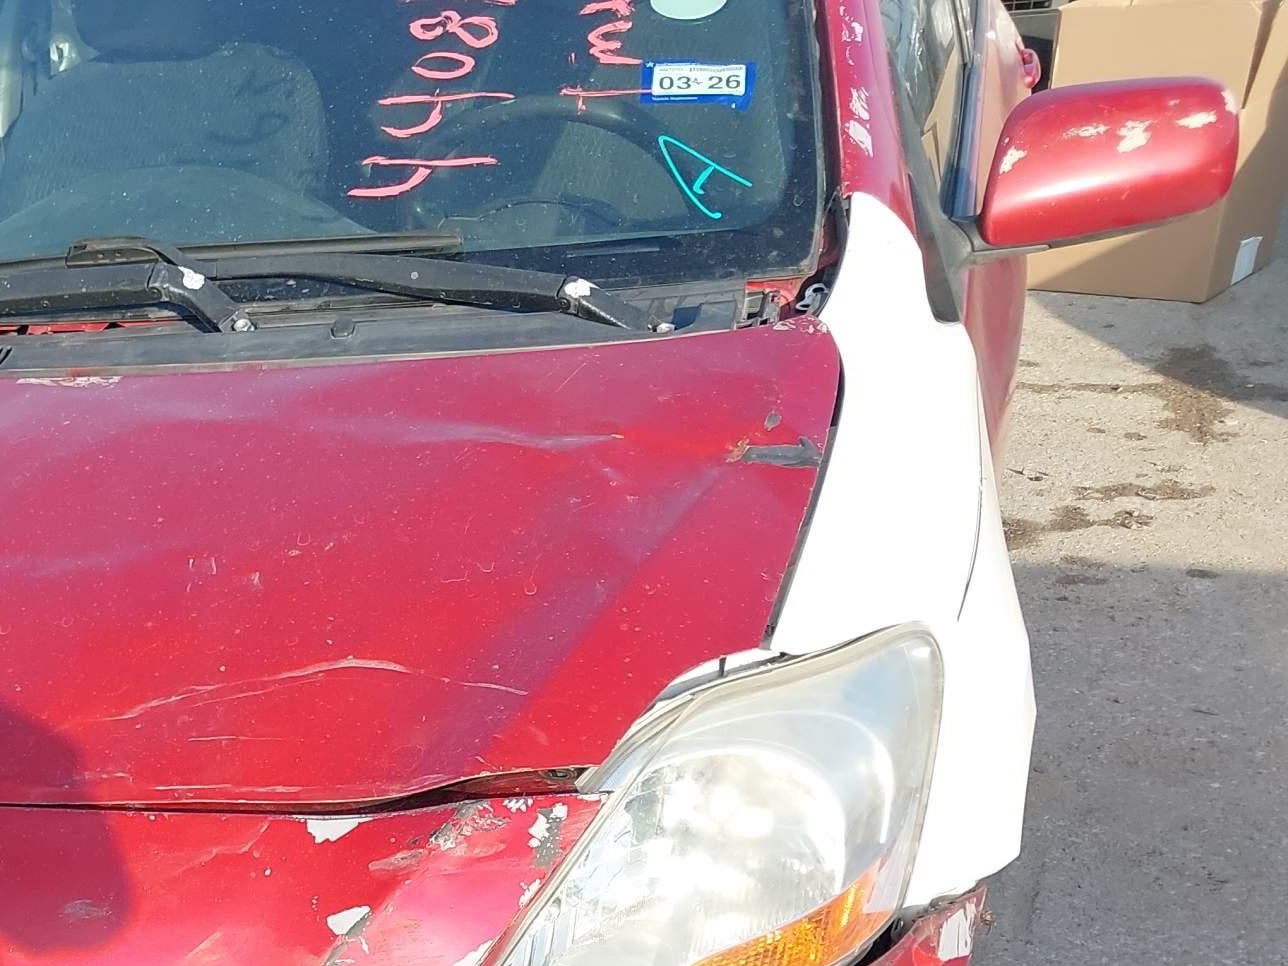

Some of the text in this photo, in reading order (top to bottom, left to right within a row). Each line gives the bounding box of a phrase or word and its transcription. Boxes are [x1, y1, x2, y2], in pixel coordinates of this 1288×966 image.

[346, 0, 519, 198] 4408
[659, 74, 741, 90] 03 26
[657, 135, 753, 219] A
